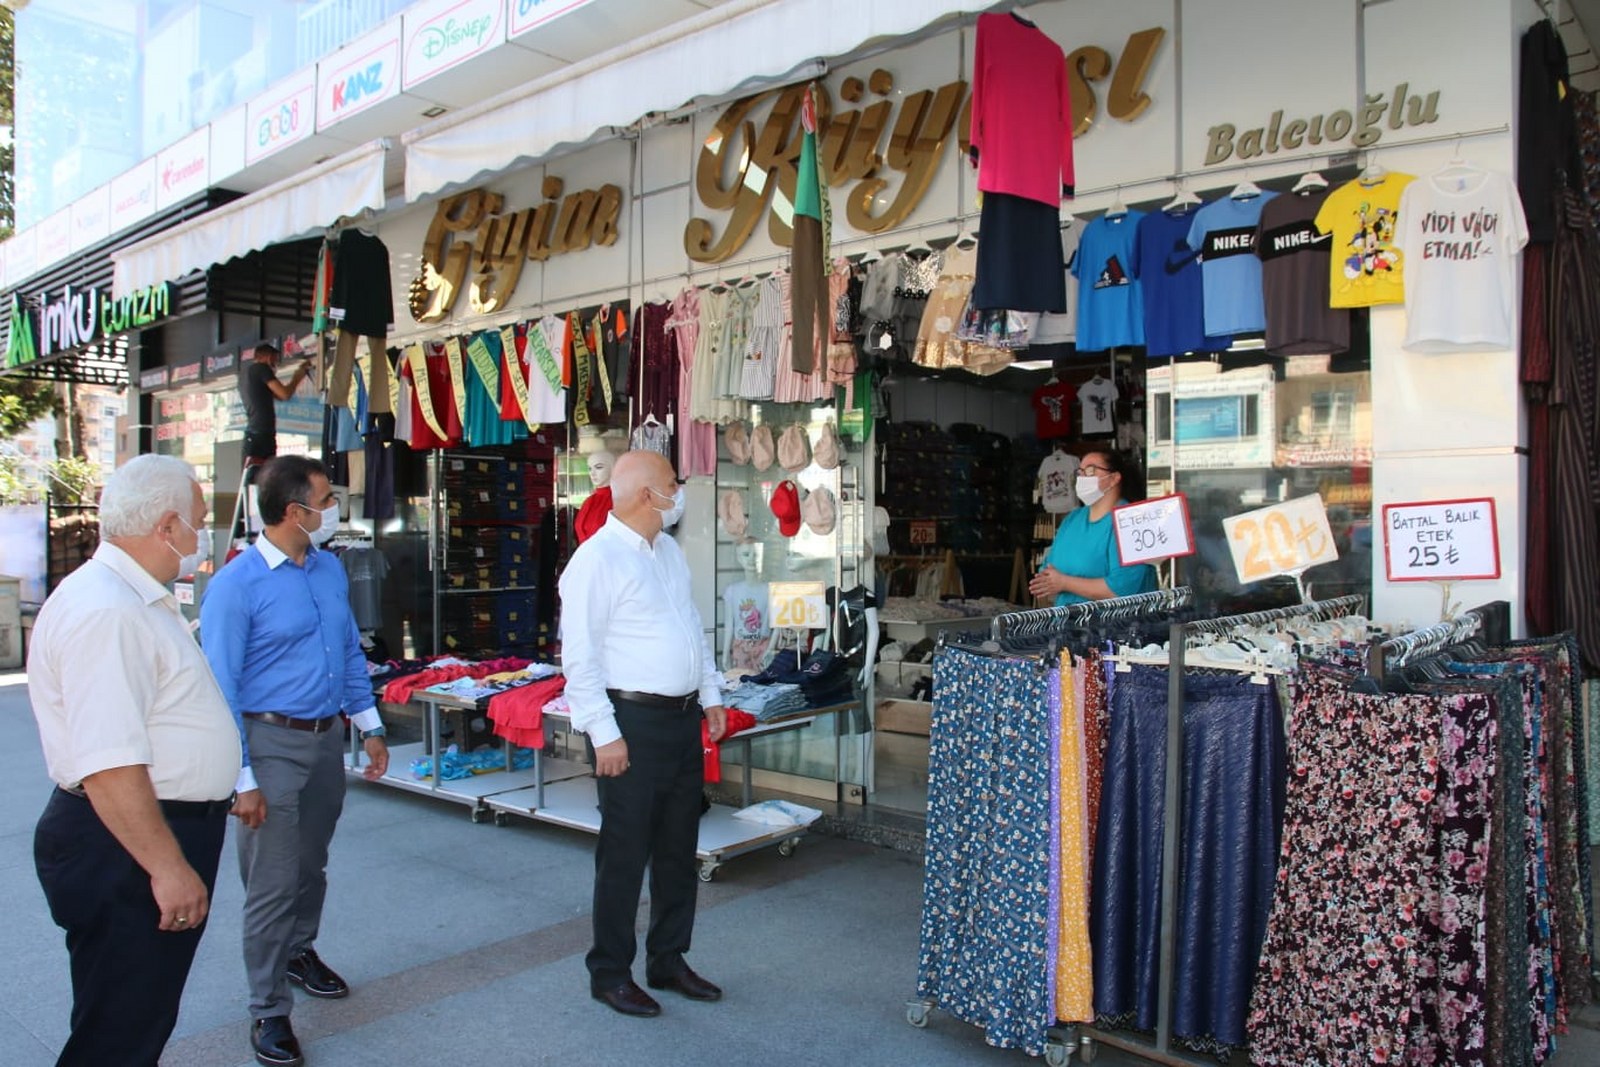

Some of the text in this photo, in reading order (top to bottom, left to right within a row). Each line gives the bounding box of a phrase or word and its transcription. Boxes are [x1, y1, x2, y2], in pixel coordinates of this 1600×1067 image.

[332, 61, 382, 112] KANZ
[1204, 82, 1440, 166] Balcıoğlu
[1213, 234, 1251, 251] NIKE
[1273, 230, 1311, 250] NIKE
[101, 281, 169, 334] turizm
[1392, 508, 1481, 530] BATTAL BALIK
[1416, 529, 1454, 543] ETEK
